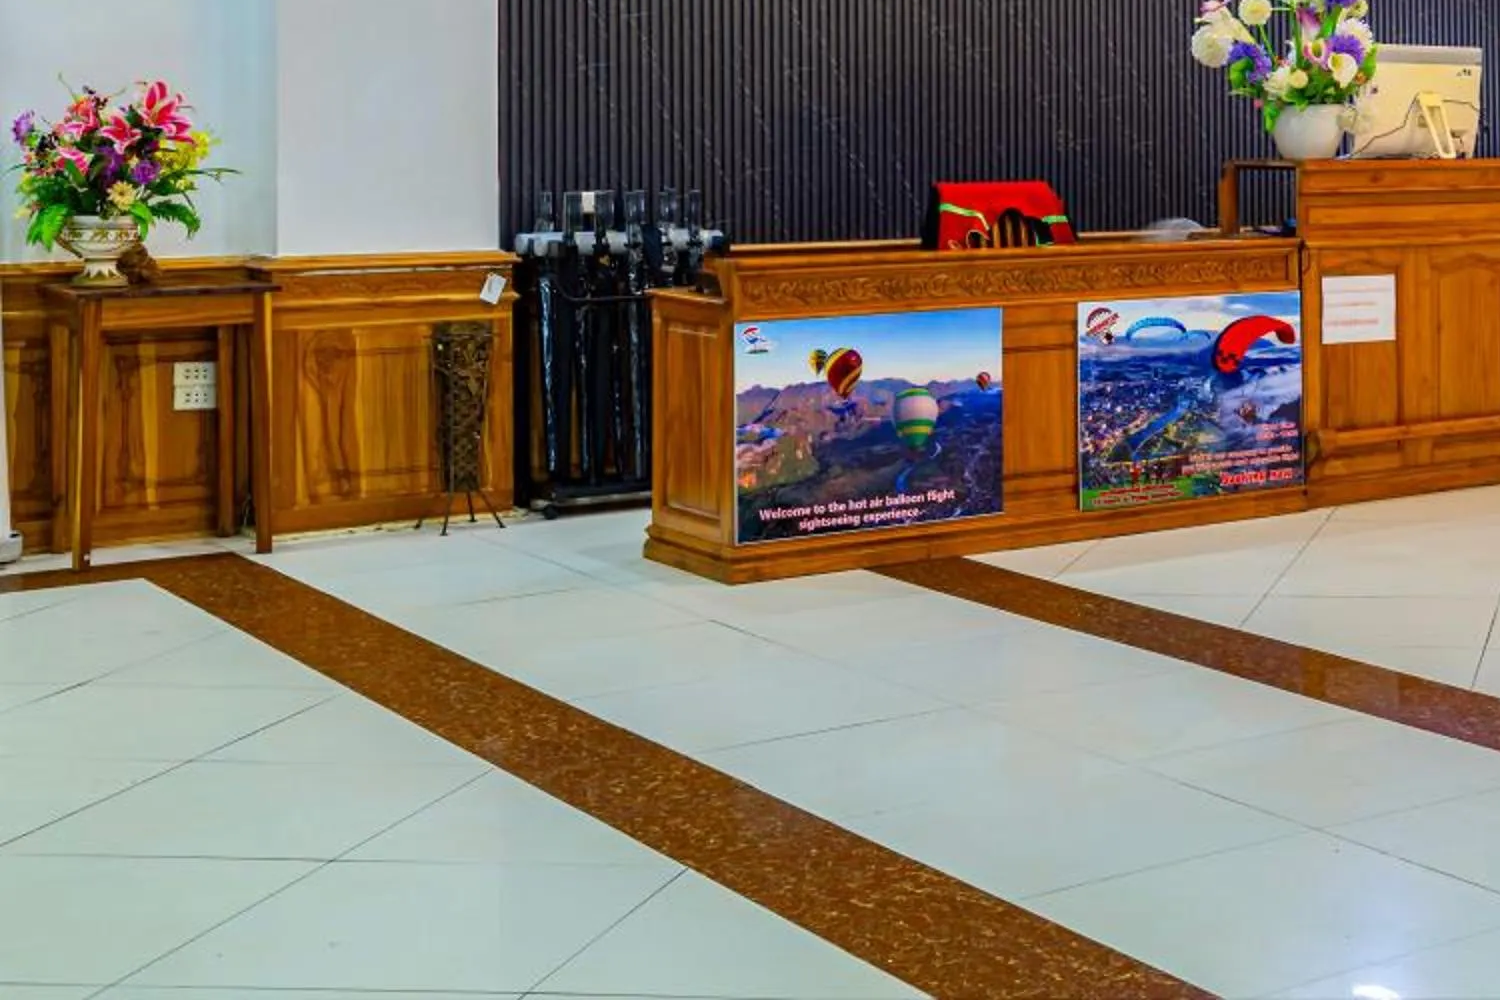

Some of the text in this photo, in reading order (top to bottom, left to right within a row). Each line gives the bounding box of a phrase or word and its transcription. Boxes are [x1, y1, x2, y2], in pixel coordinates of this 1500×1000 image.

[759, 488, 956, 521] Welcome to the hot air balloon flight
[799, 513, 861, 531] sightseeing
